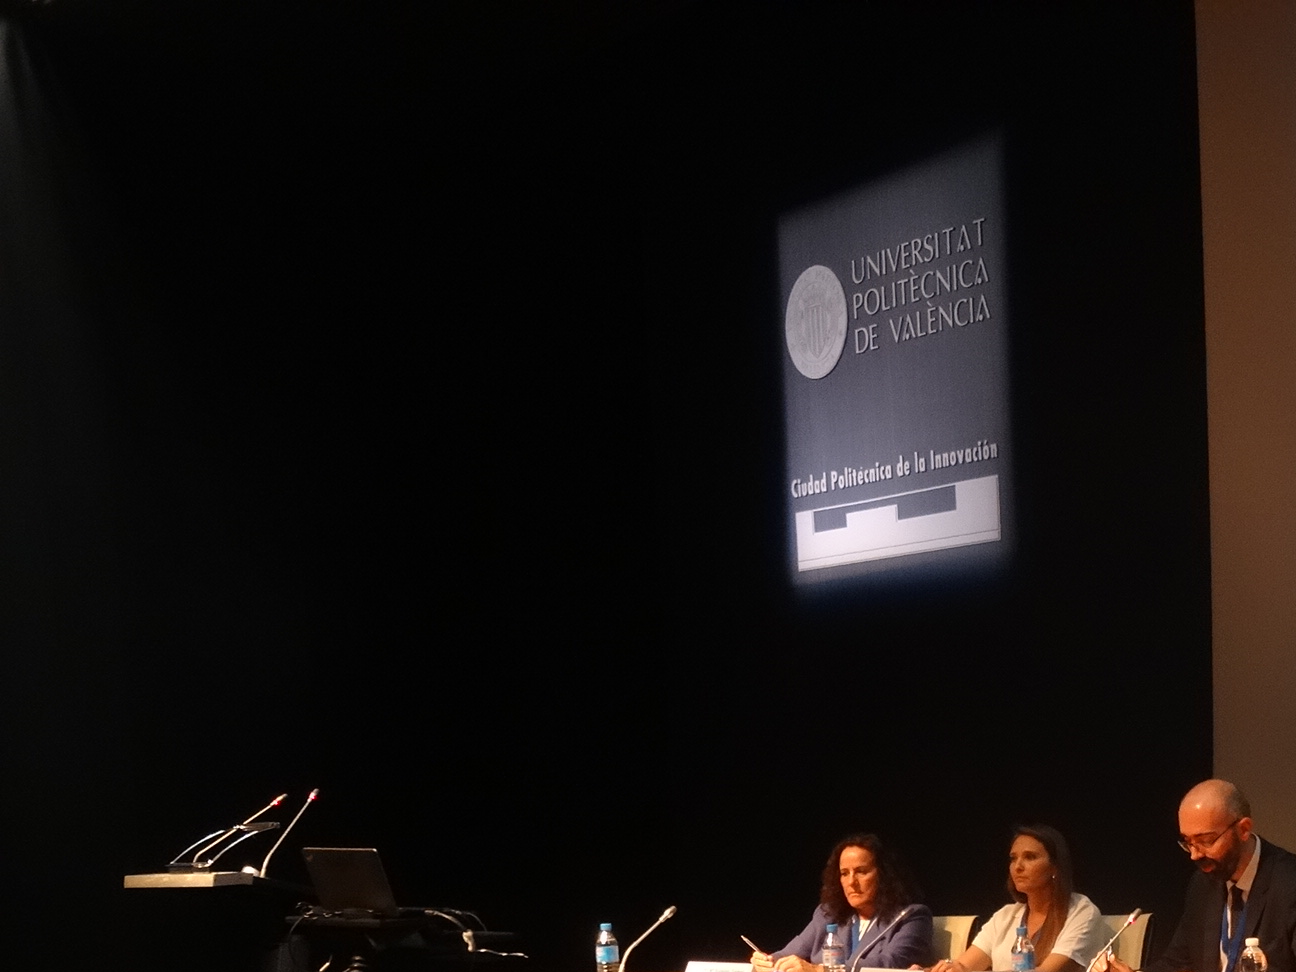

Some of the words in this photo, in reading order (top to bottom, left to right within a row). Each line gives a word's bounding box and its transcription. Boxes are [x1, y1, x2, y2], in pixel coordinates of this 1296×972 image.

[851, 217, 986, 286] UNIVERSITAT
[853, 257, 990, 320] POLITÈCNICA
[855, 323, 880, 355] DE
[890, 295, 991, 344] VALÈNCIA
[791, 472, 827, 498] Ciudad
[831, 461, 893, 491] Politécnica
[896, 455, 911, 477] de
[914, 451, 926, 474] la
[930, 440, 998, 470] Innovación
